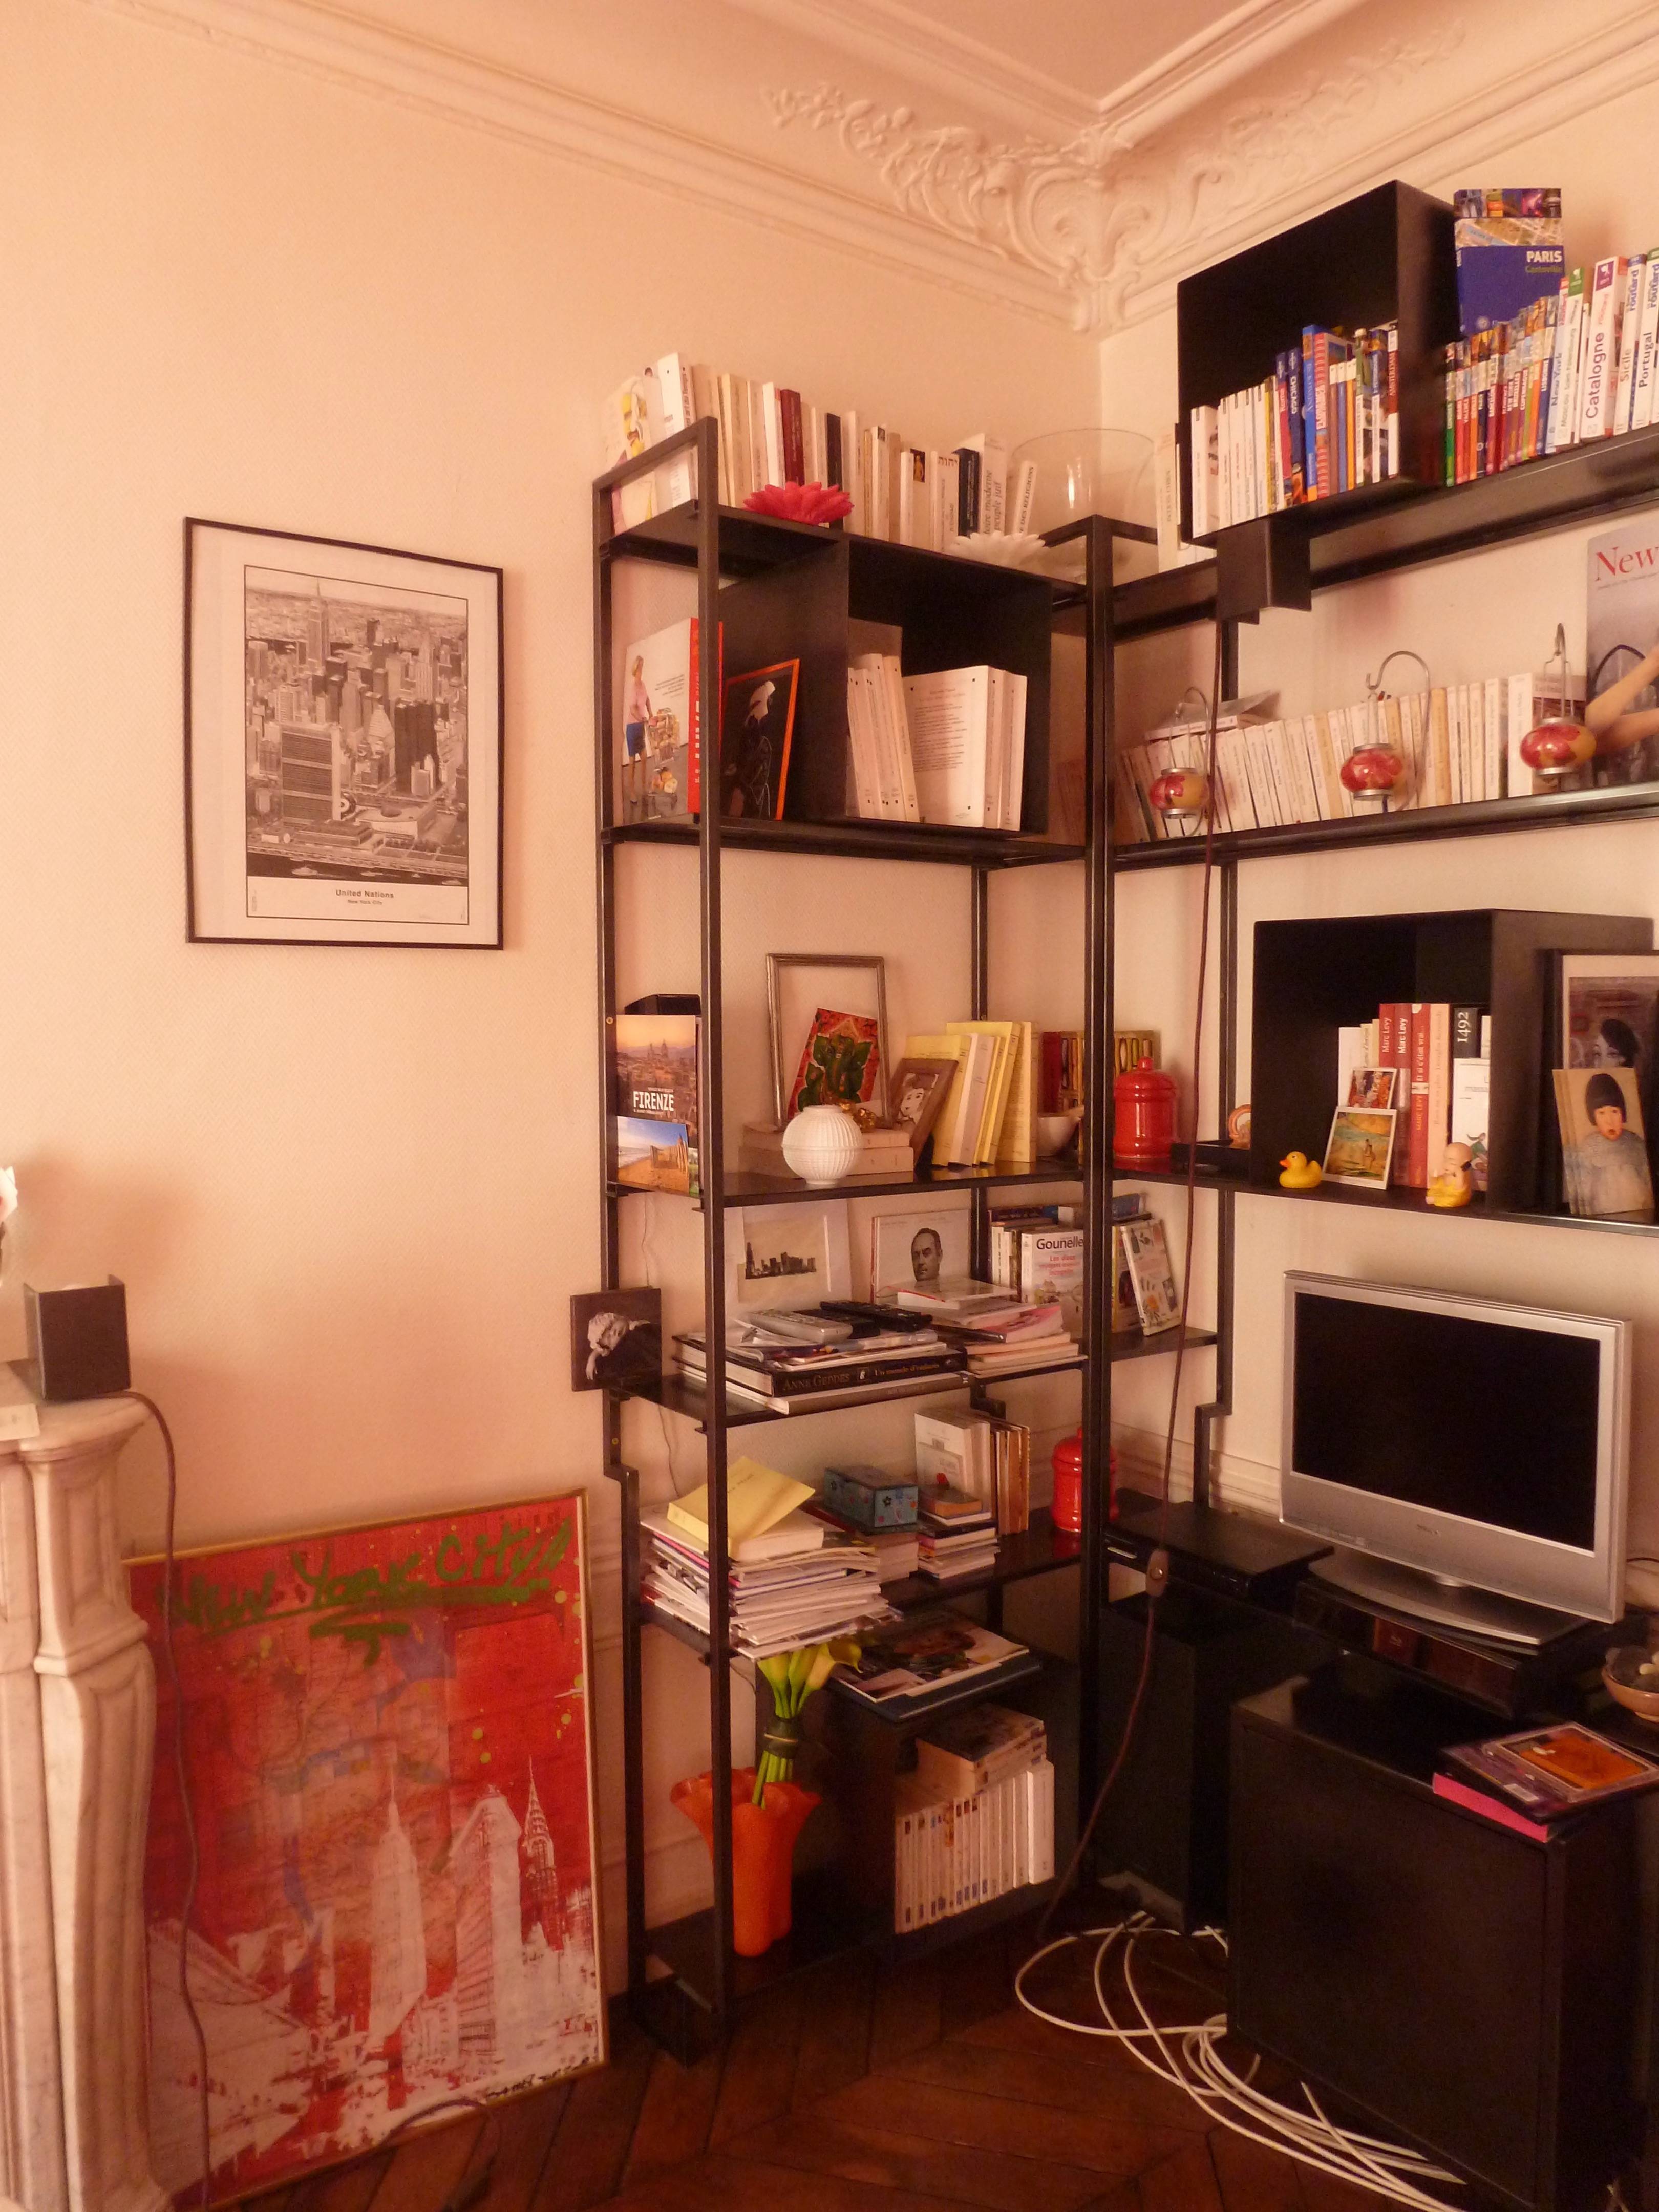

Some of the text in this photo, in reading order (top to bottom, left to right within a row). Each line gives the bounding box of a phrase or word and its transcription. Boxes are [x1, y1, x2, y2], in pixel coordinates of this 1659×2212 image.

[1526, 250, 1562, 264] PARIS
[1629, 269, 1639, 312] routard
[1586, 332, 1606, 419] Catalogne
[1621, 348, 1632, 383] Sicile
[1639, 332, 1654, 388] Portugal
[1290, 376, 1298, 415] CHICAGO
[1520, 368, 1528, 410] COPENHAGUE
[984, 470, 992, 512] moderne
[993, 481, 1004, 499] juif
[1023, 466, 1034, 508] RELIGIONS
[1595, 545, 1659, 581] New
[1383, 1017, 1392, 1032] Levy
[1398, 1017, 1408, 1054] Marc Levy
[1457, 1011, 1471, 1043] 1492
[1417, 1073, 1424, 1081] Et
[633, 1091, 674, 1112] FIRENZE
[1036, 1236, 1083, 1249] Gounelle
[782, 1373, 850, 1391] ANNE GEDDES
